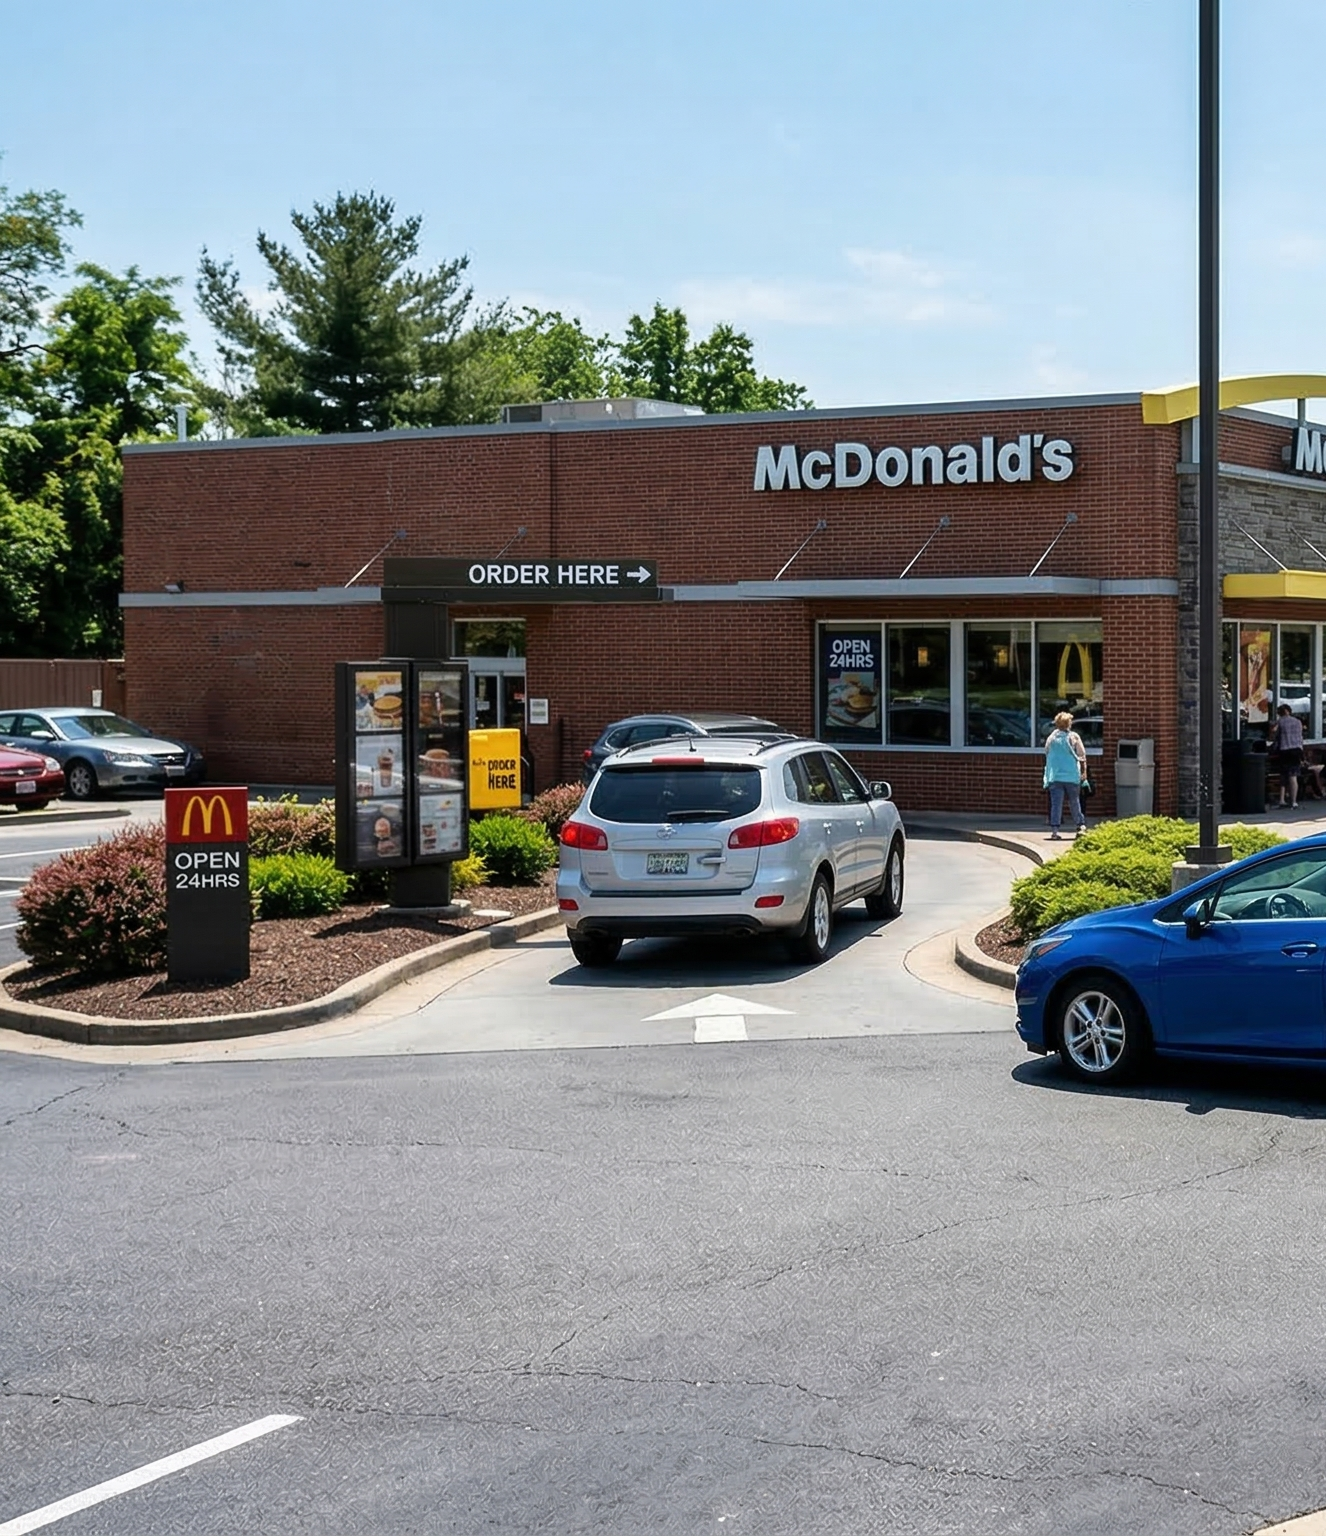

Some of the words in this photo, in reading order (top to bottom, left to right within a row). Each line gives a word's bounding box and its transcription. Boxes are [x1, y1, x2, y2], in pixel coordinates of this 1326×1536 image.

[753, 434, 1074, 491] McDonald's
[468, 564, 550, 584] ORDER
[557, 565, 619, 584] HERE
[832, 639, 871, 653] OPEN
[829, 654, 874, 668] 24HRS
[488, 772, 516, 790] HERE
[175, 852, 240, 869] OPEN
[176, 873, 240, 888] 24HRS
